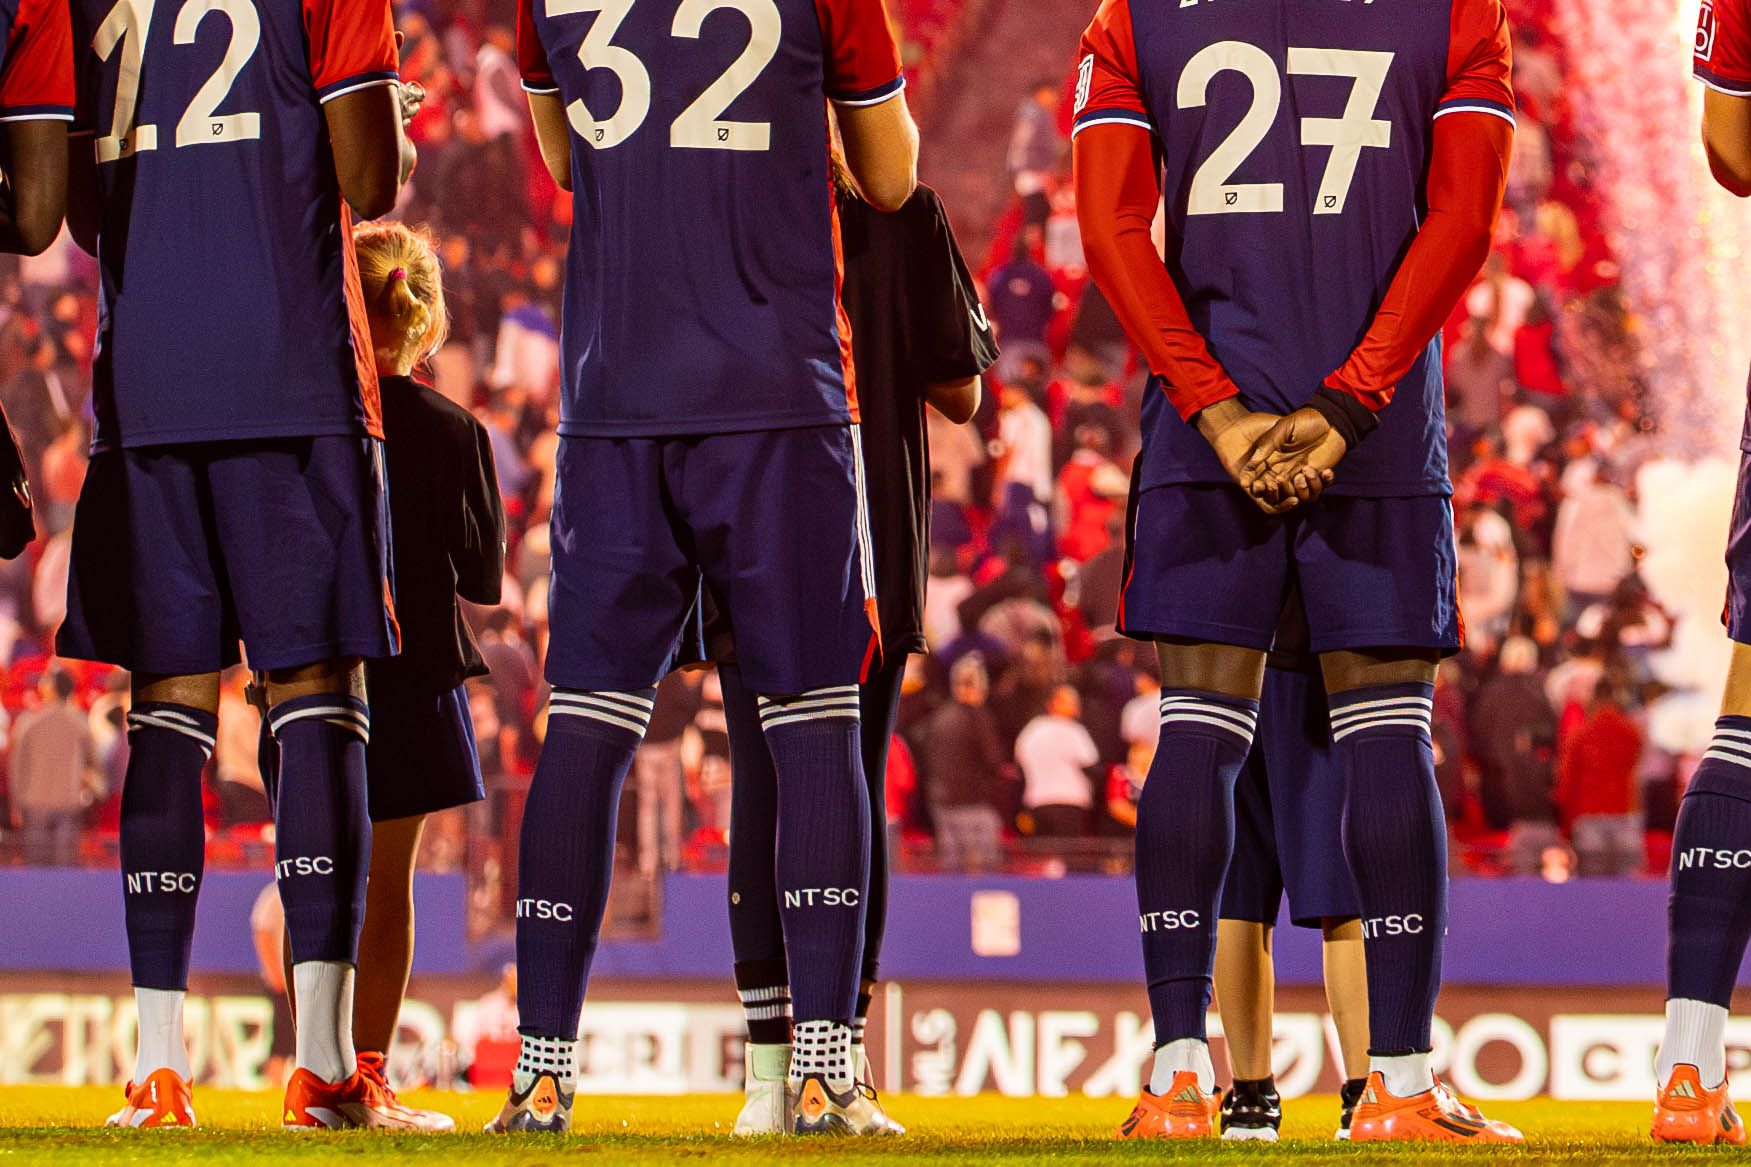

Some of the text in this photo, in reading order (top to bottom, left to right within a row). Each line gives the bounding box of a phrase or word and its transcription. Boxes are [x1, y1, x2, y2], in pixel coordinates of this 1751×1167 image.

[1176, 40, 1395, 216] 27
[275, 856, 334, 881] NTSC
[127, 871, 196, 894] NTSC
[785, 887, 860, 909] NTSC
[516, 899, 573, 922] NTSC
[1139, 910, 1200, 933] NTSC
[1361, 913, 1424, 941] NTSC
